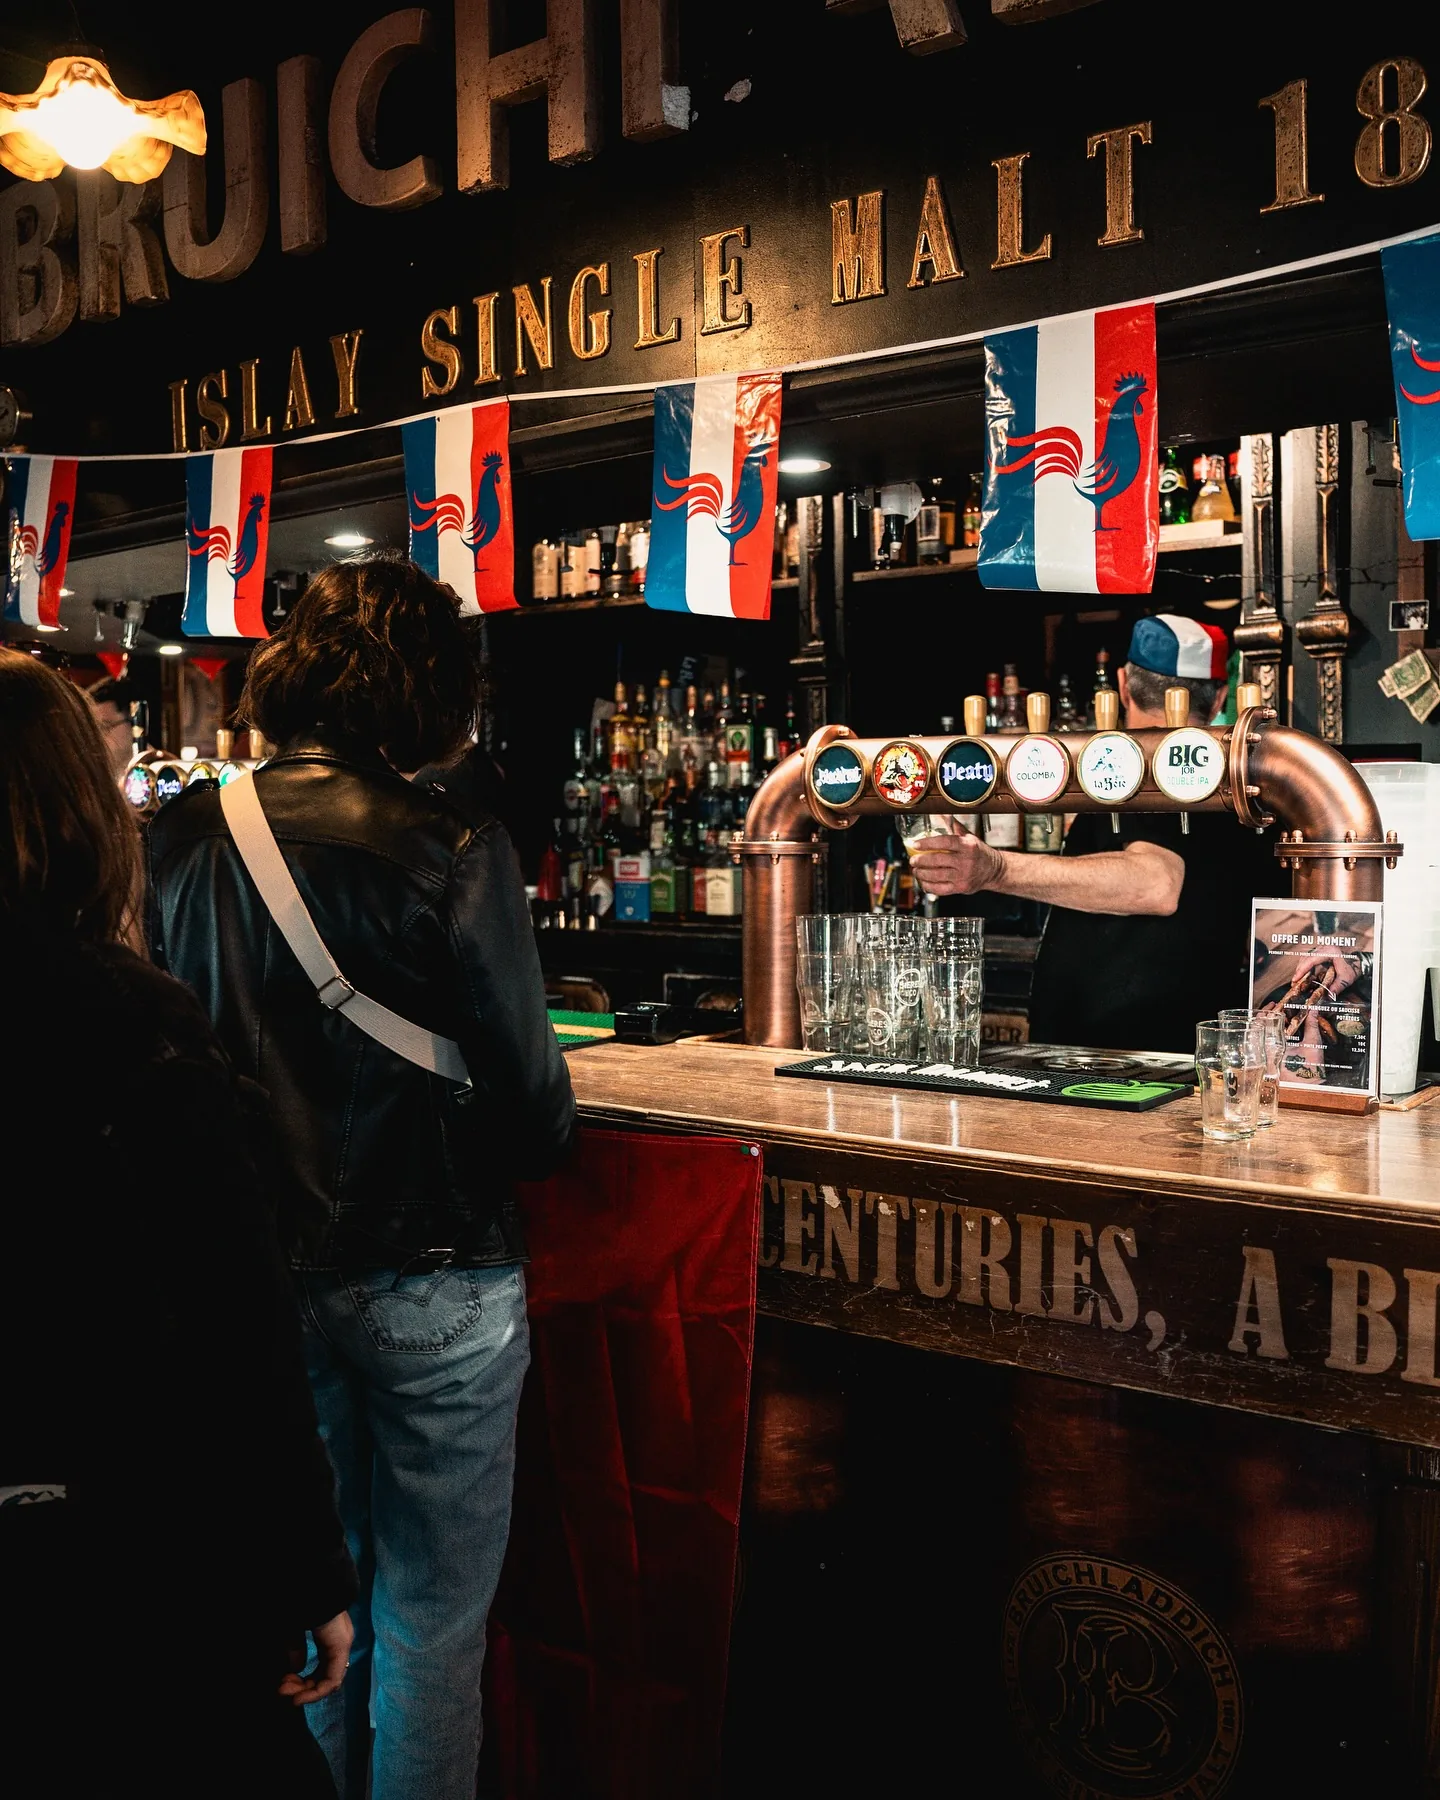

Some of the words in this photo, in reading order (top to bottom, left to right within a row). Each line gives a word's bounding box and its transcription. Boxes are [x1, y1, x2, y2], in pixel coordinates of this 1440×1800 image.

[168, 329, 366, 453] ISLAY
[421, 225, 751, 400] SINGLE
[830, 120, 1153, 306] MALT
[1168, 744, 1209, 767] BIG
[941, 762, 993, 786] Peaty
[1016, 771, 1056, 781] COLOMBA
[1181, 766, 1195, 775] JOB
[1197, 776, 1209, 785] IPA
[1271, 933, 1299, 944] OFFRE
[1301, 935, 1314, 945] DU
[1316, 936, 1357, 947] MOMENT
[758, 1175, 1166, 1352] CENTURIES,
[1228, 1246, 1289, 1361] A
